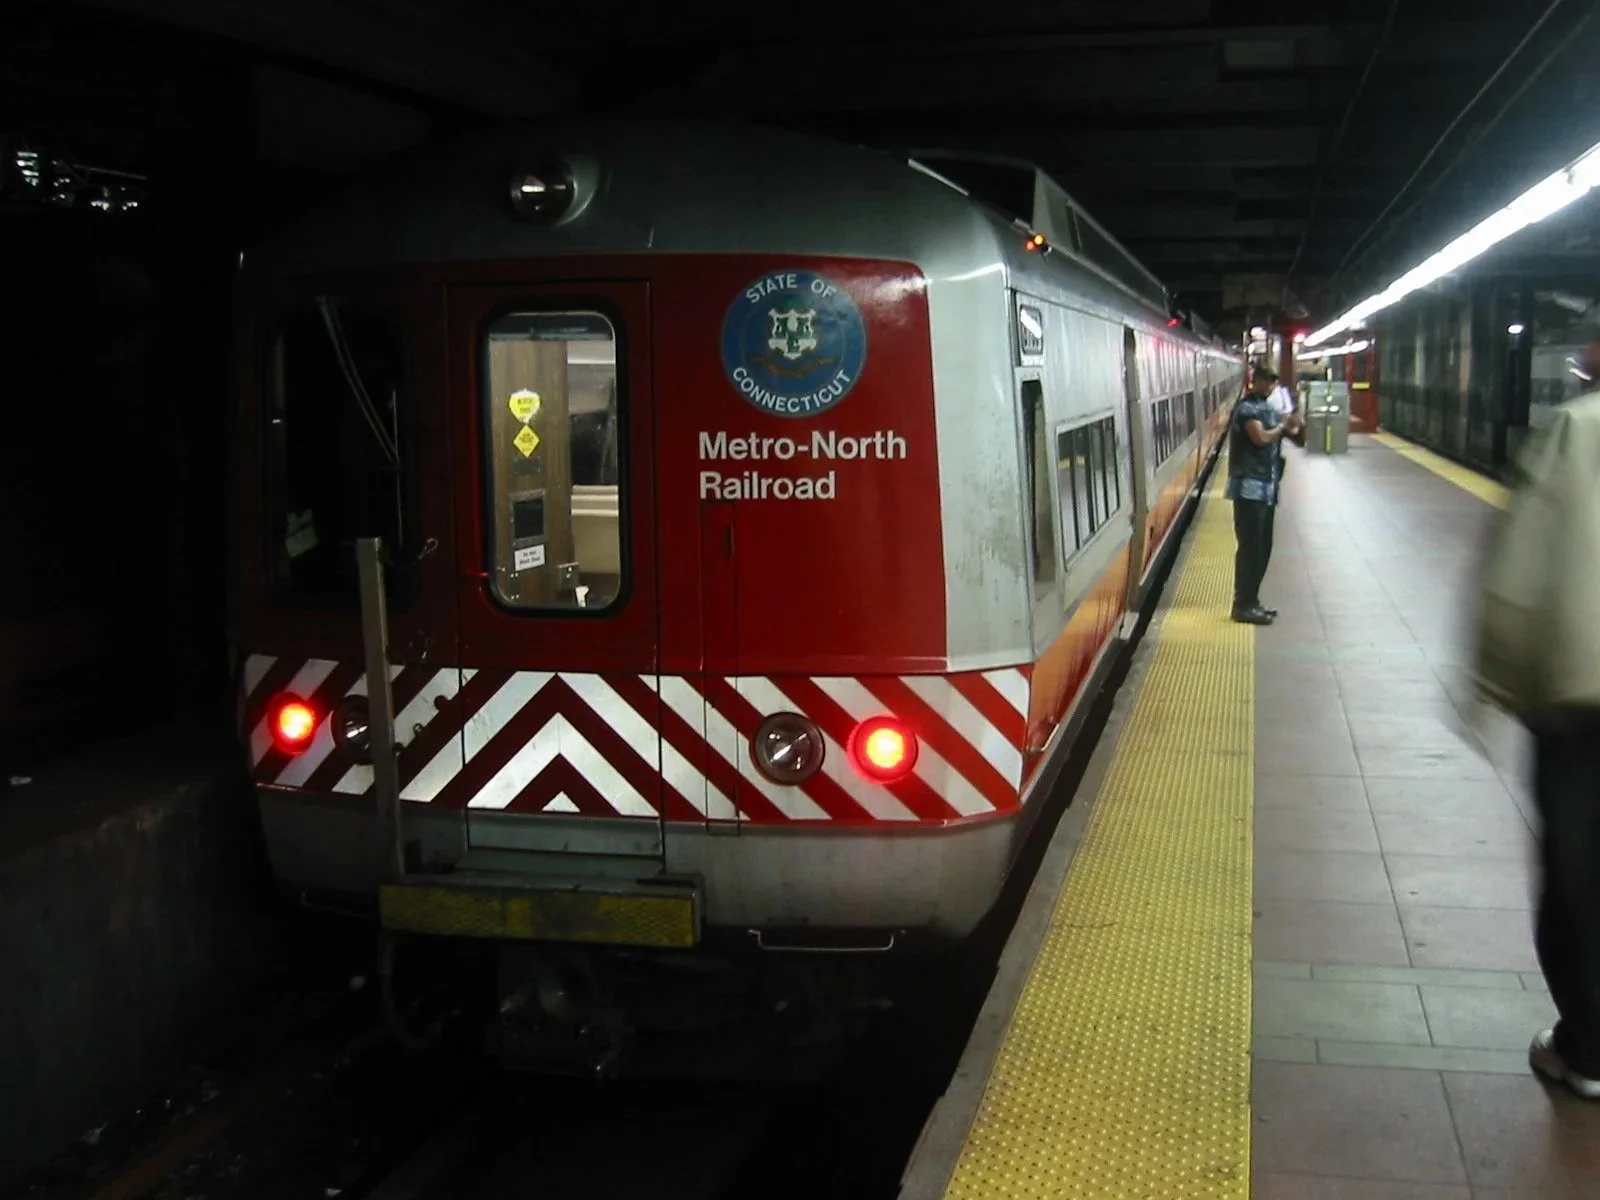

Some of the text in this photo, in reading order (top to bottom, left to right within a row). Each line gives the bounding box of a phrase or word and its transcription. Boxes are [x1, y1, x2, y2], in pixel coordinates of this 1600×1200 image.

[746, 273, 837, 303] STATE OF
[732, 367, 851, 413] CONNECTICUT
[699, 430, 907, 460] Metro-North
[699, 471, 836, 500] Railroad
